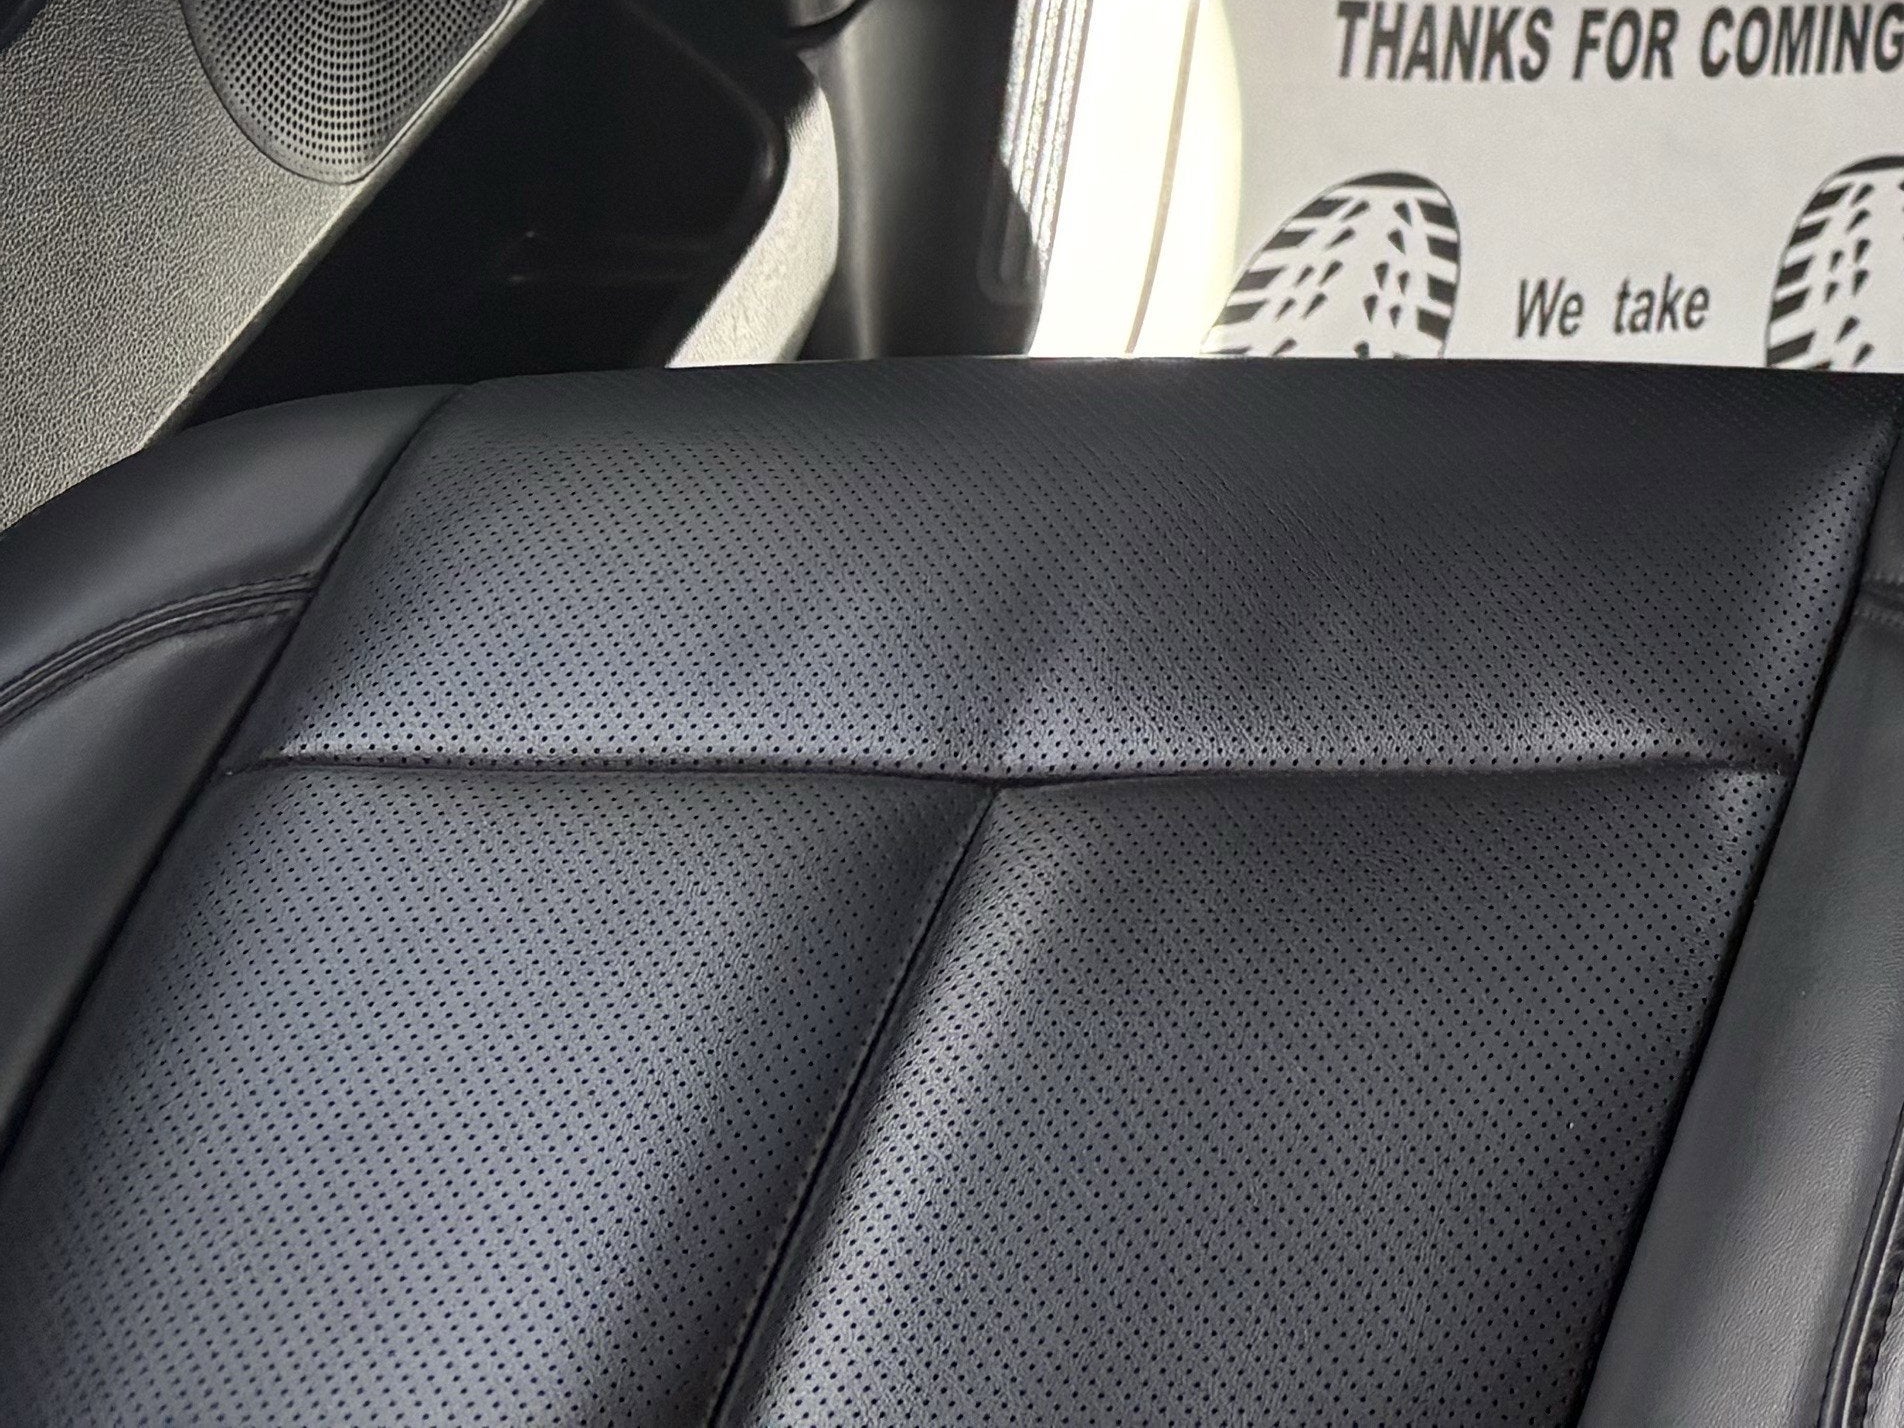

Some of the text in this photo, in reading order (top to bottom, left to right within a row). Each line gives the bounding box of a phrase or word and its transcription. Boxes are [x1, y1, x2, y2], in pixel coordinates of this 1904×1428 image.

[1571, 4, 1680, 82] FOR
[1515, 276, 1712, 342] We take
